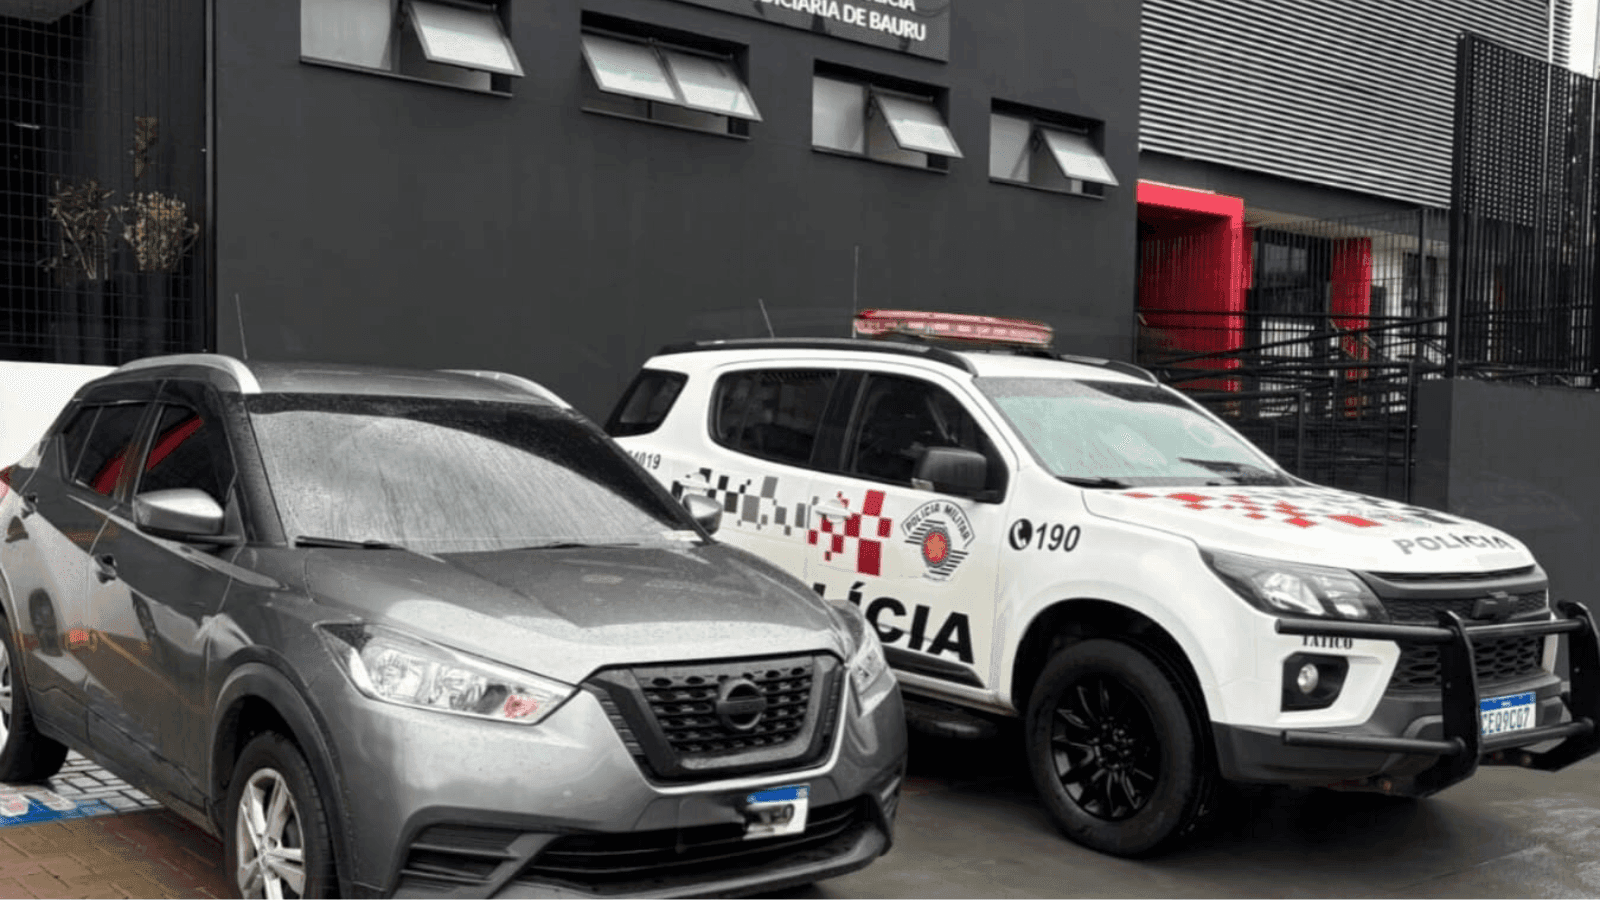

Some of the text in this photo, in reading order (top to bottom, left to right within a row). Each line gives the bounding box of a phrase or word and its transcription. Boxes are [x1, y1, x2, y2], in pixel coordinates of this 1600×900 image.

[843, 4, 867, 27] DE
[869, 11, 927, 41] BAURU
[1036, 522, 1081, 552] 190
